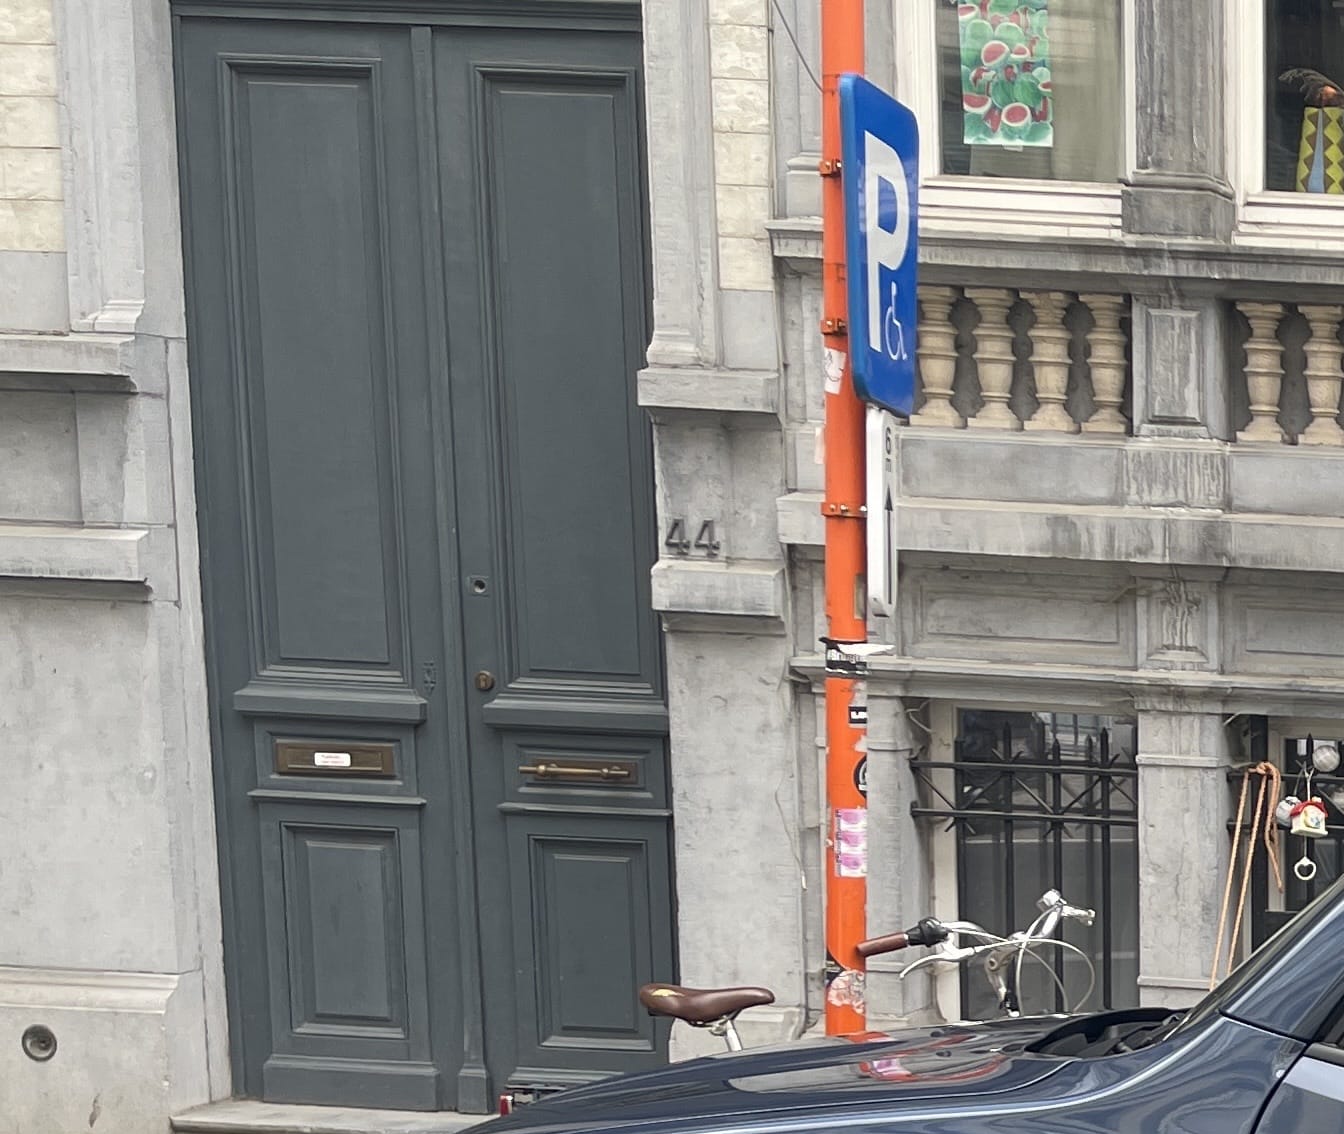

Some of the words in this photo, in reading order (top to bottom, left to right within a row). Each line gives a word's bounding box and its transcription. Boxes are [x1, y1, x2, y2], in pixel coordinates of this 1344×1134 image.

[864, 130, 909, 353] P
[885, 426, 892, 455] 6
[665, 518, 720, 558] 44
